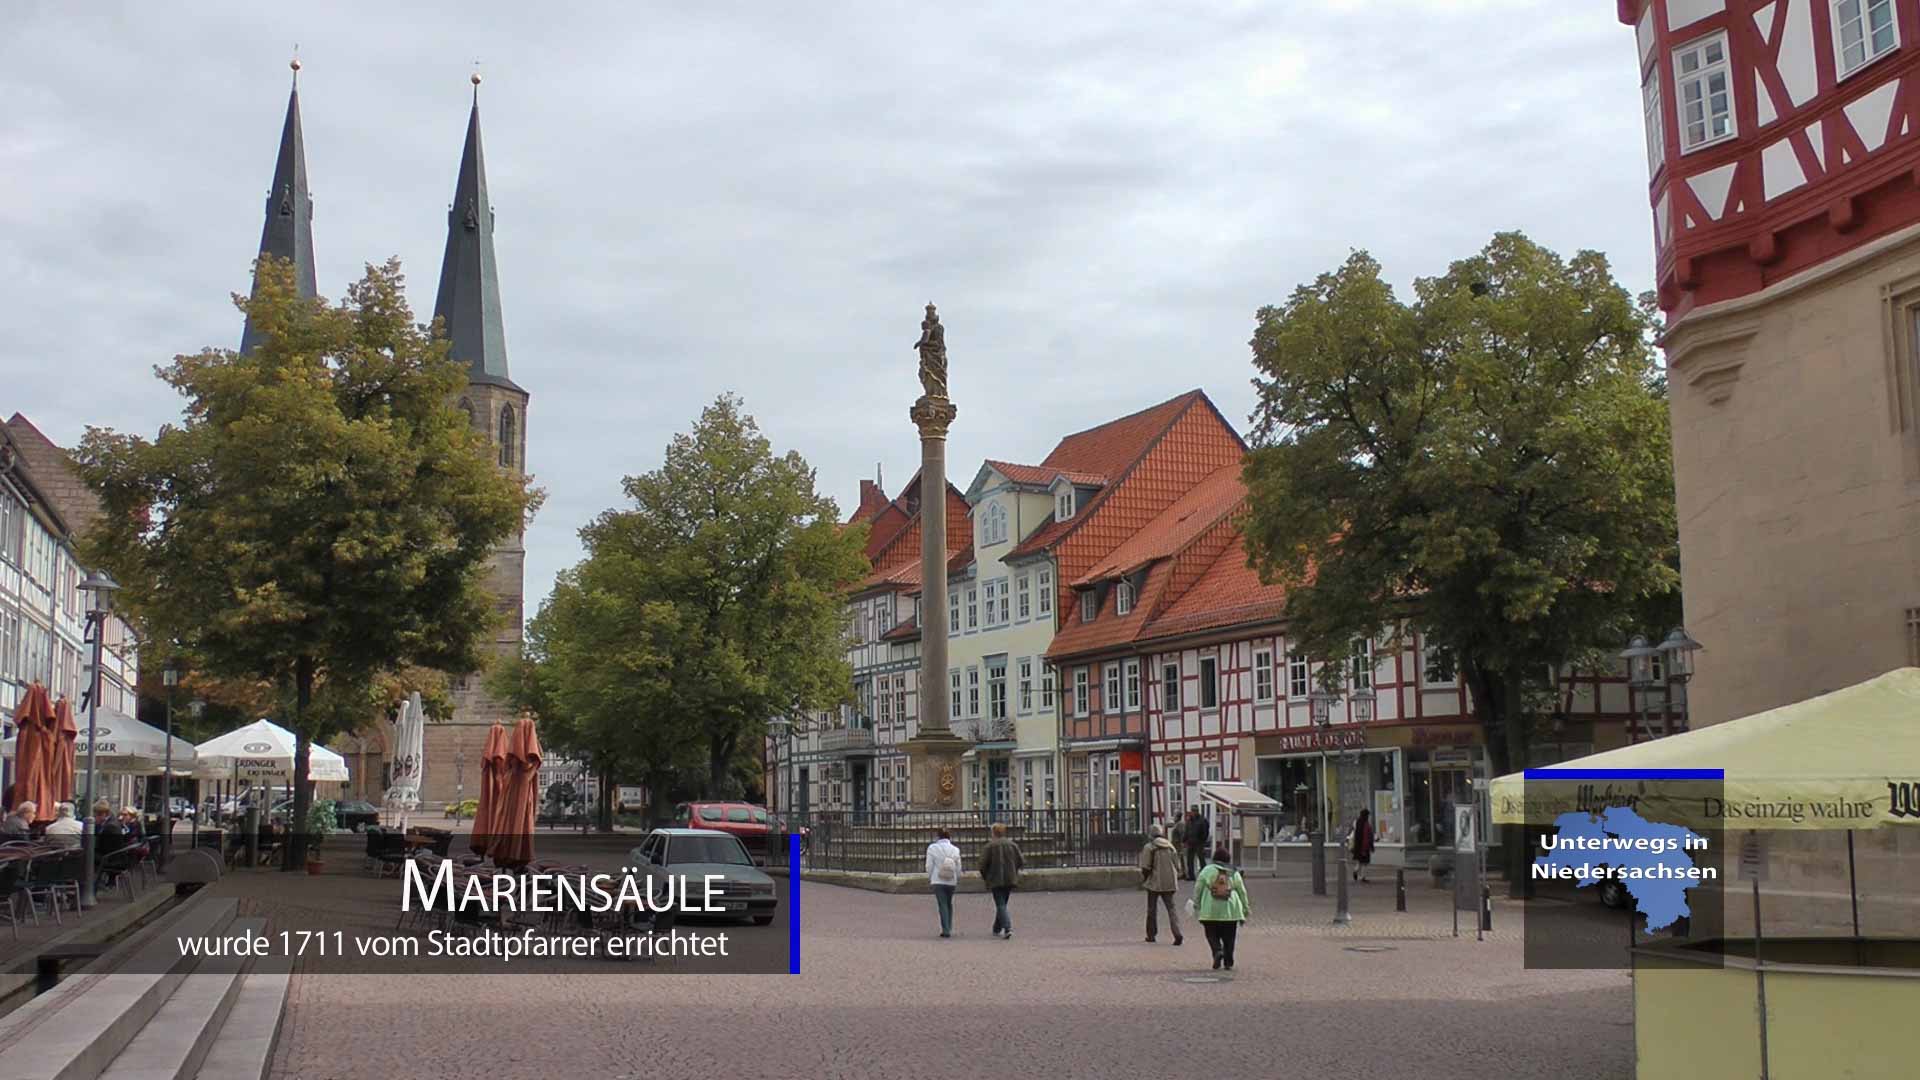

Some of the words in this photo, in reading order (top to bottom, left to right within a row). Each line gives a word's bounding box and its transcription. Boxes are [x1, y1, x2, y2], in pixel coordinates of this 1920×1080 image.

[1704, 797, 1742, 818] Das
[1744, 797, 1805, 823] einzig
[1808, 797, 1873, 818] wahre
